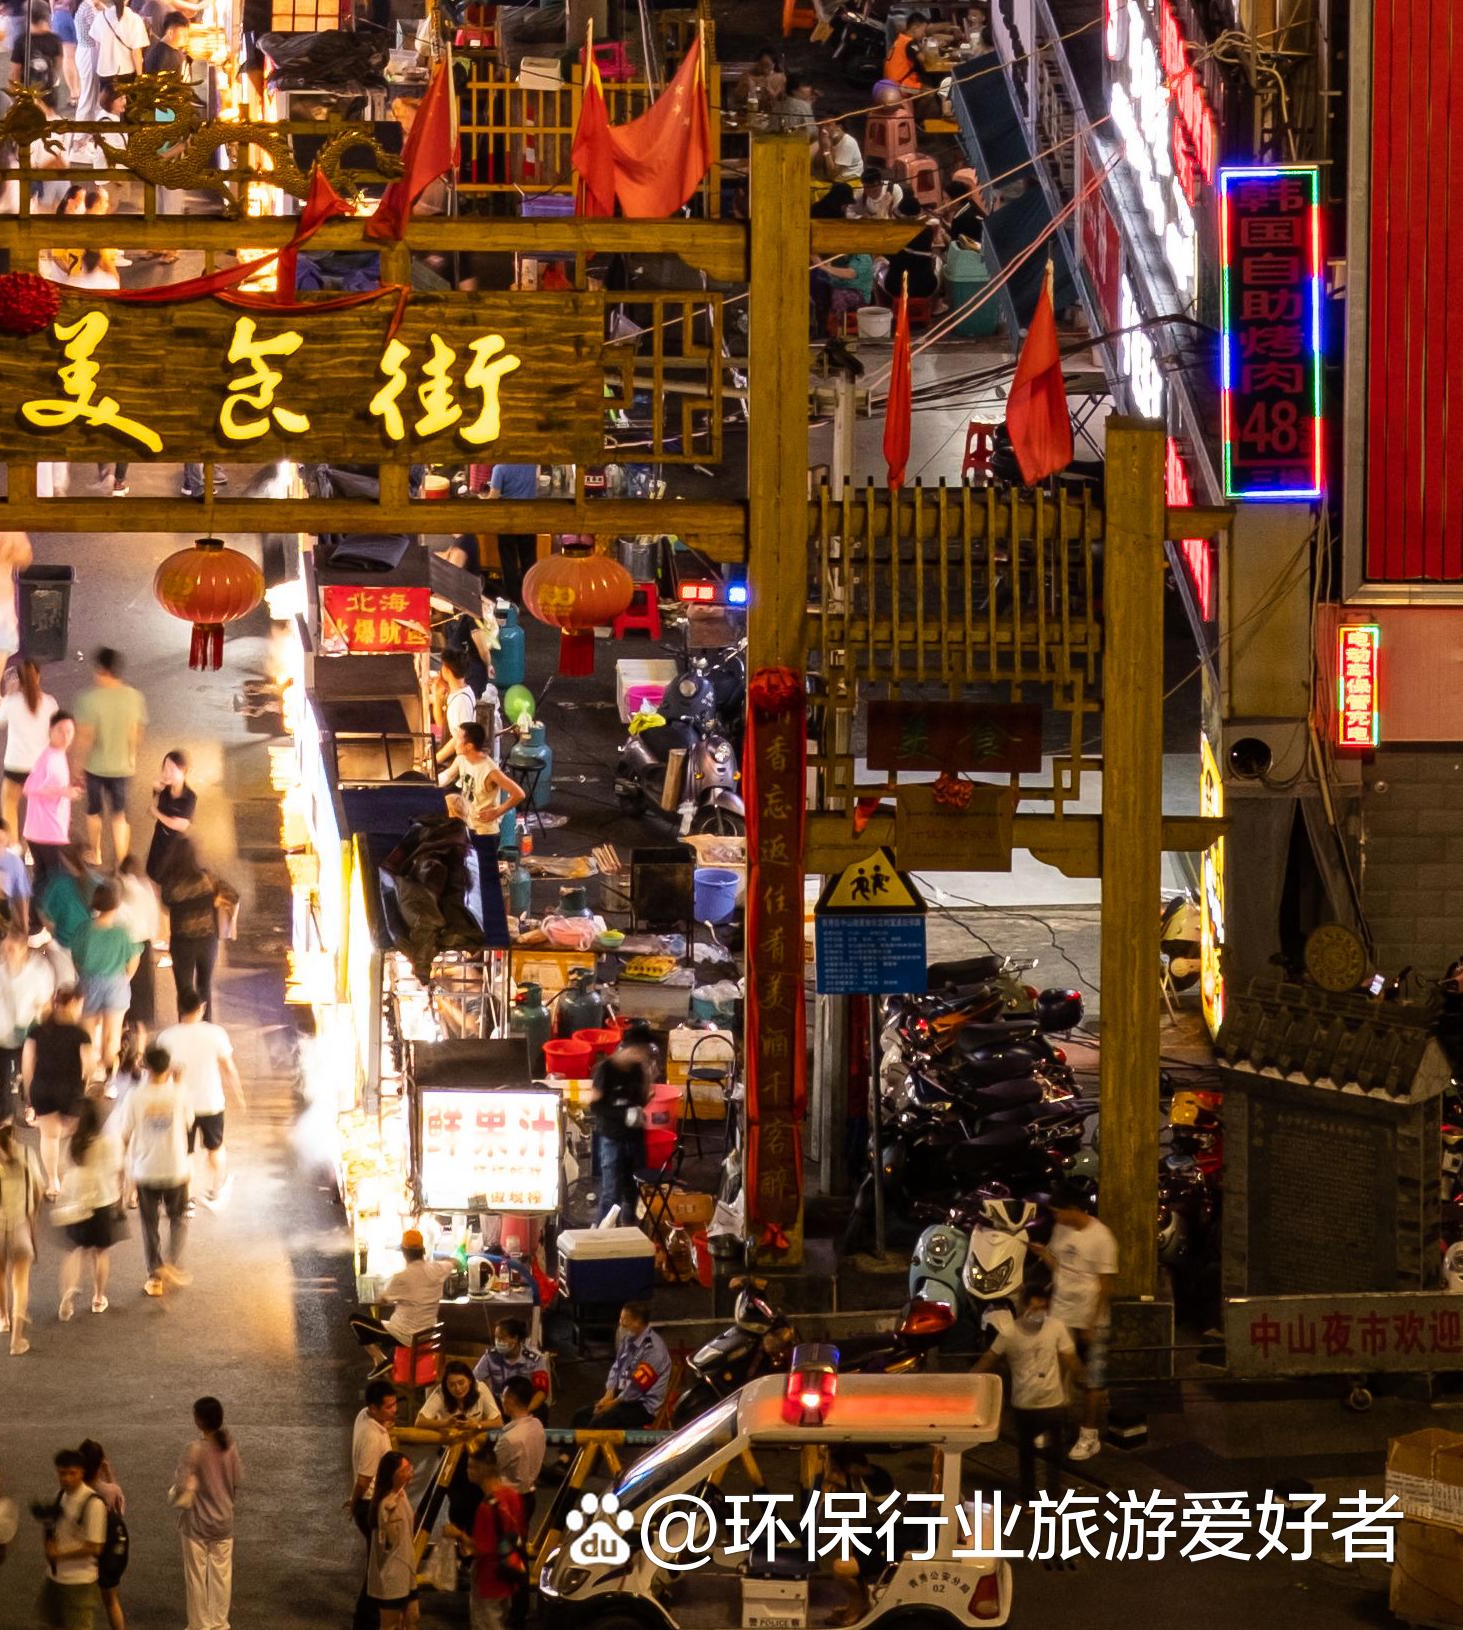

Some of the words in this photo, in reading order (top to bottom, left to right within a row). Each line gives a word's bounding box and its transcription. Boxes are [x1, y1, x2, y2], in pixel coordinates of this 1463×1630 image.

[1239, 180, 1304, 394] 韩国自助烤肉
[1241, 402, 1298, 454] 48
[345, 592, 410, 613] 北海
[1250, 1311, 1463, 1358] 中山夜市欢迎
[932, 1584, 945, 1593] 02
